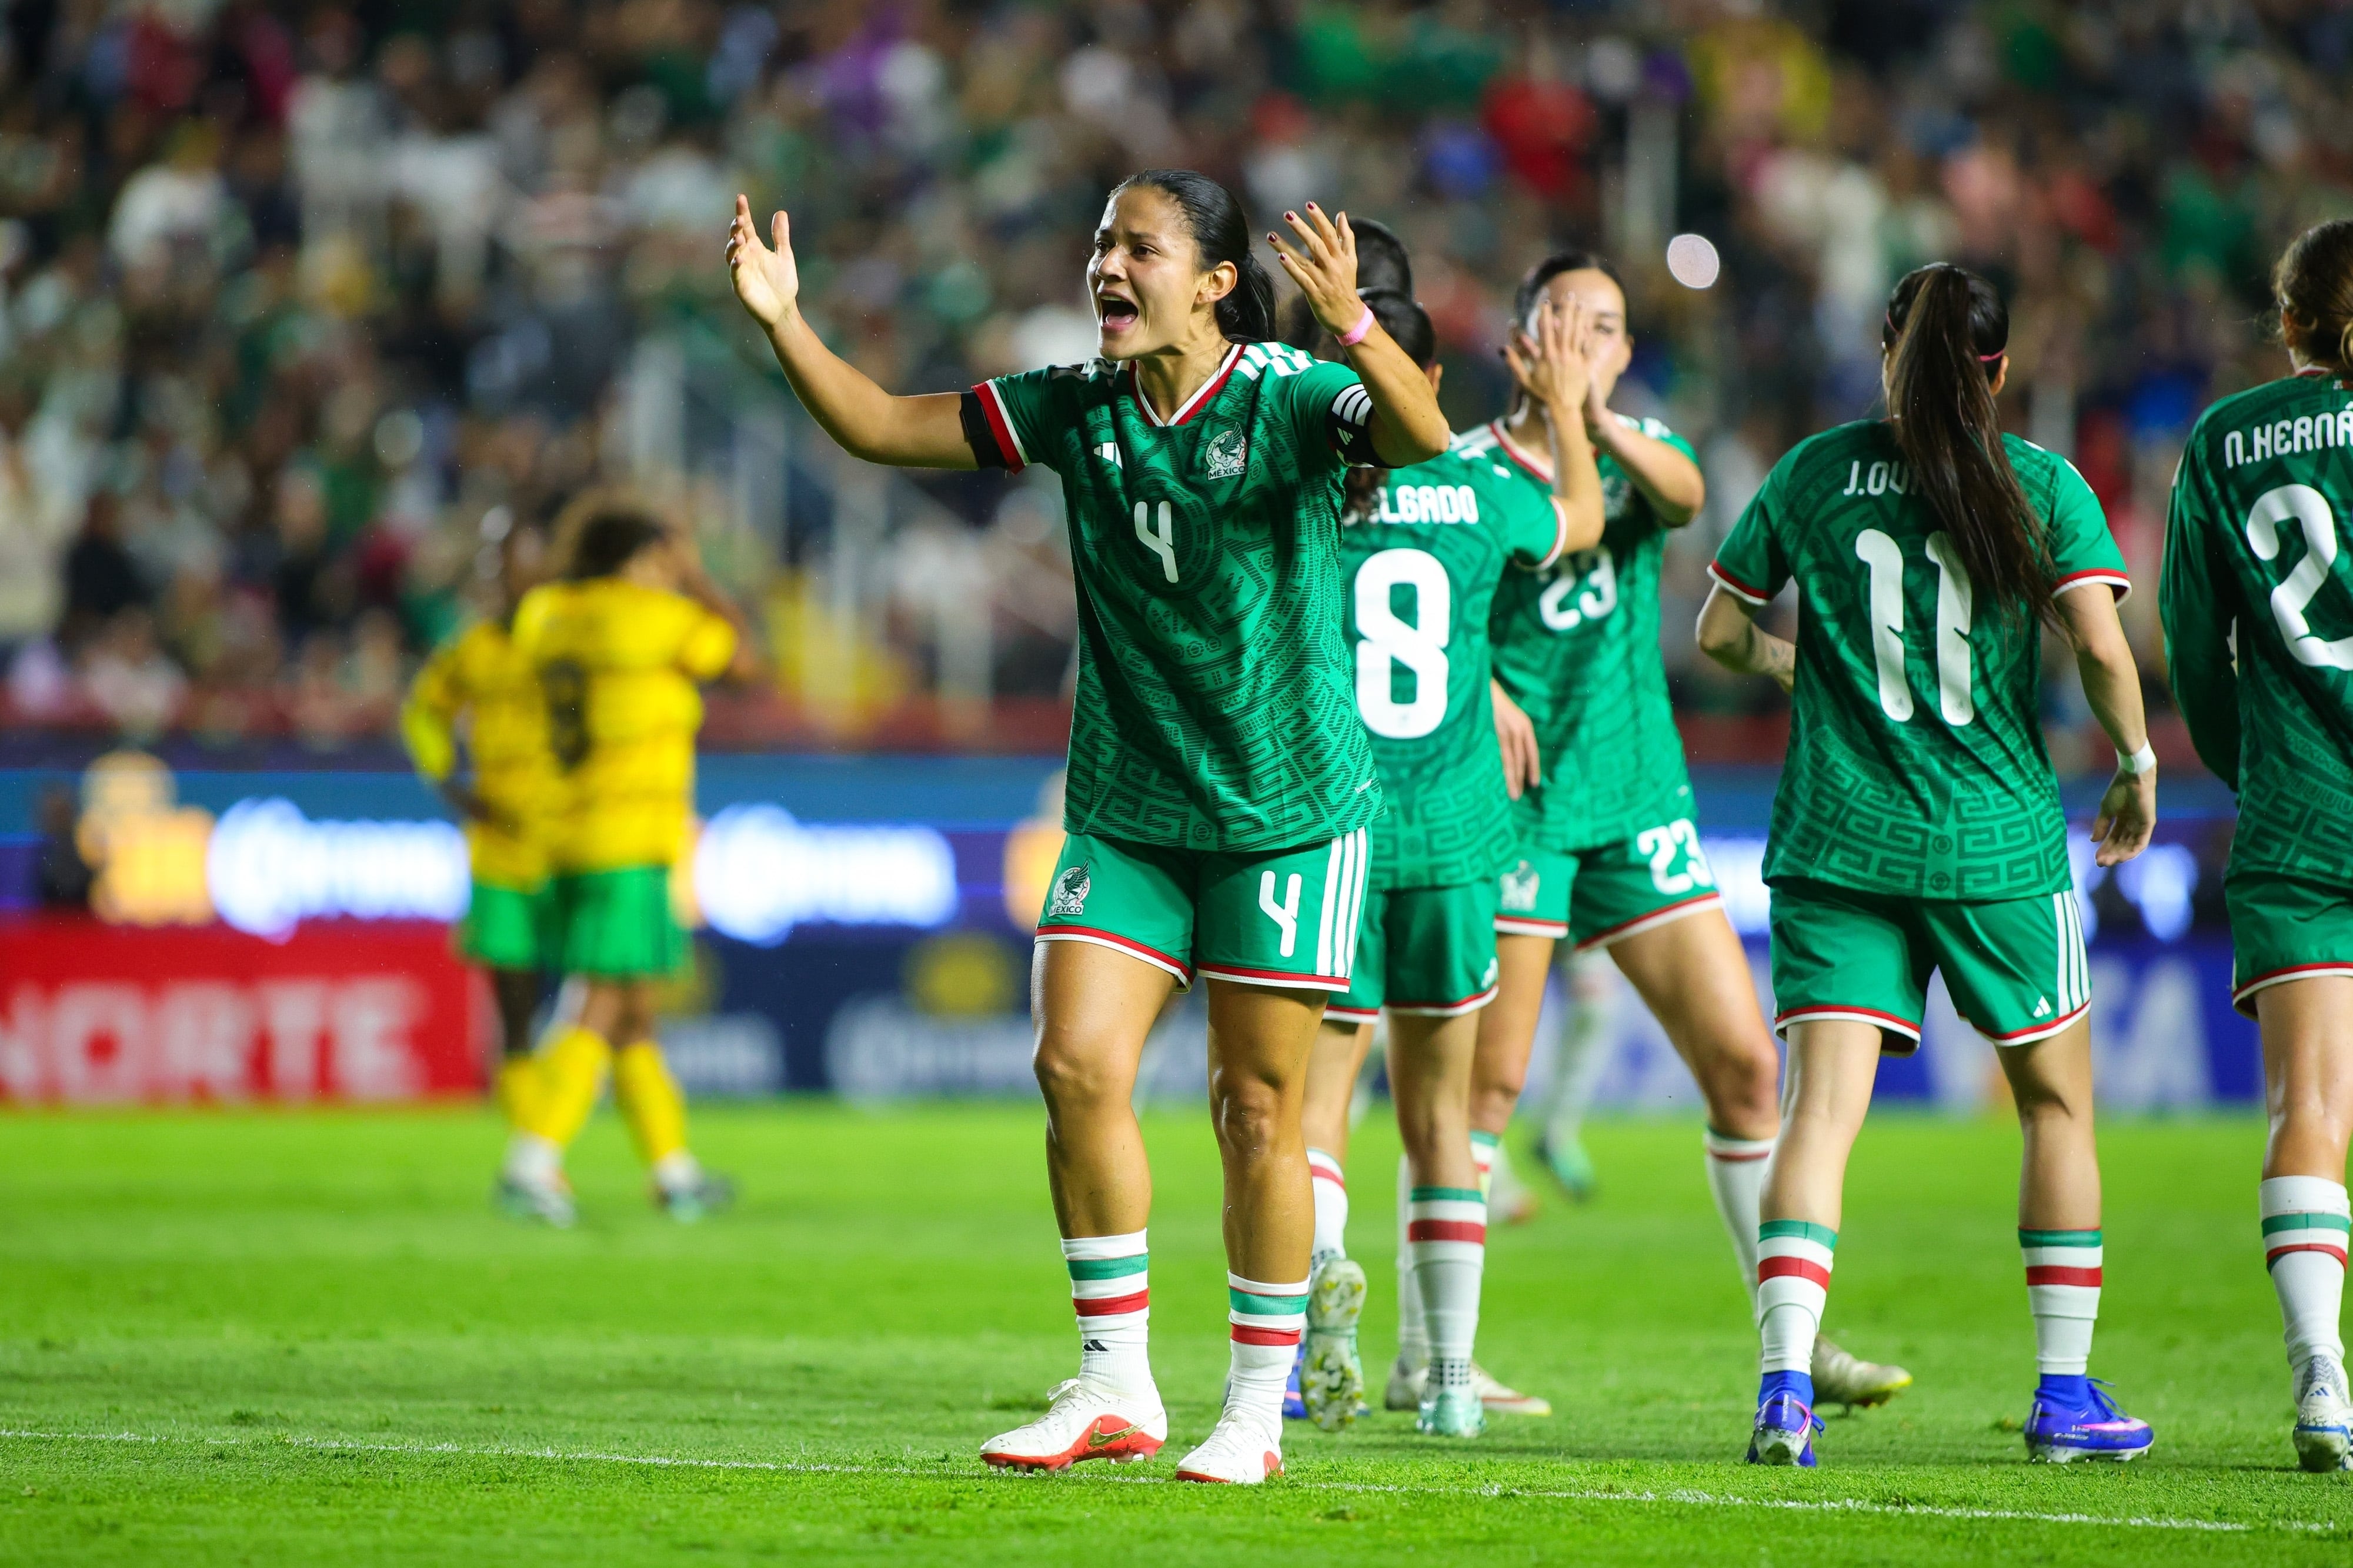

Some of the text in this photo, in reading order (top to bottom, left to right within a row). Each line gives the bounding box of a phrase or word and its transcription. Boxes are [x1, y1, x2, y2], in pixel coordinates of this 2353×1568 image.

[1209, 466, 1246, 479] MÉXICO
[1134, 501, 1179, 583] 4
[1538, 544, 1618, 631] 23
[1855, 529, 1975, 727] 11
[1354, 548, 1451, 740] 8
[1637, 818, 1714, 895] 23
[1258, 870, 1303, 958] 4
